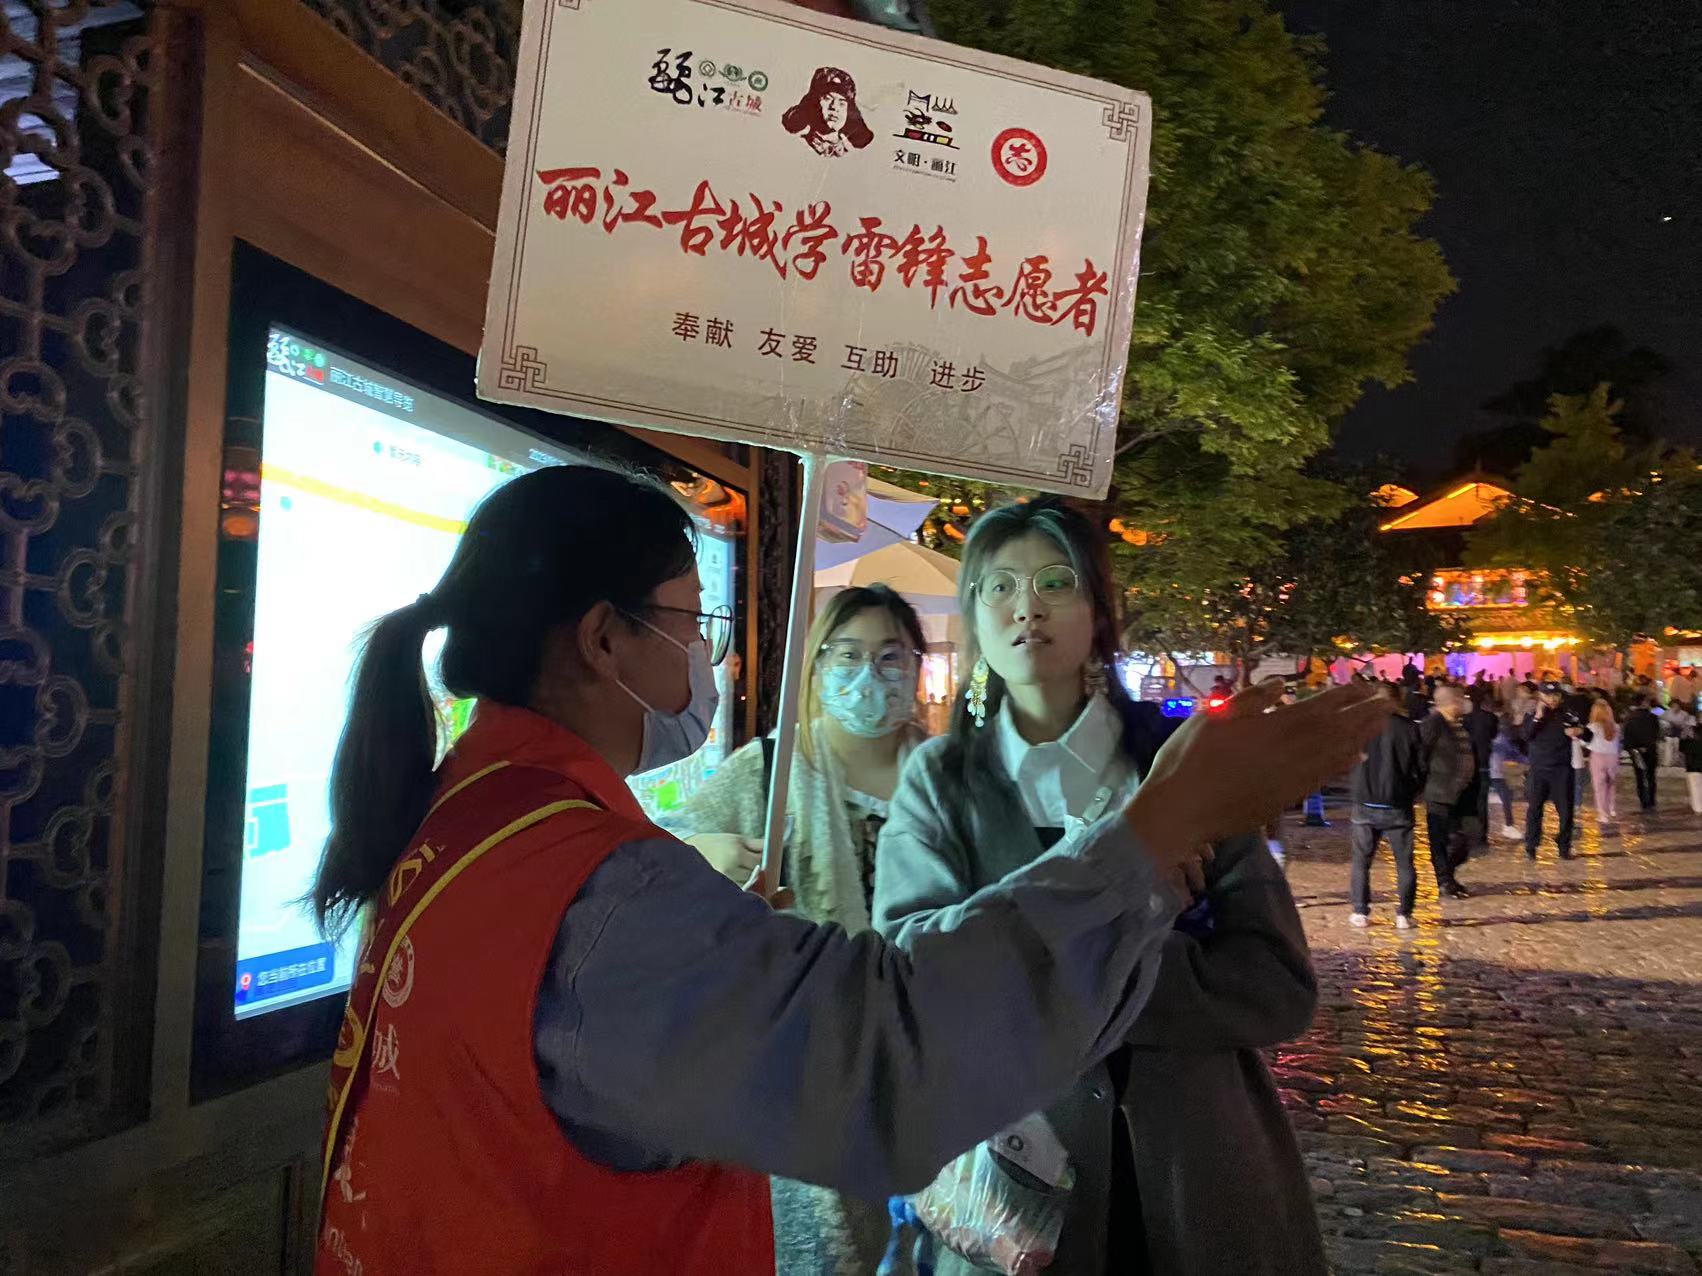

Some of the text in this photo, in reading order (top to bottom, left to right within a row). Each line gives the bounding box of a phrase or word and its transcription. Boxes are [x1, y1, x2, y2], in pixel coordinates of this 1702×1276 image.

[536, 166, 1110, 337] 丽江古城学雷锋志愿者
[671, 311, 987, 393] 奉献 友爱 互助 进步
